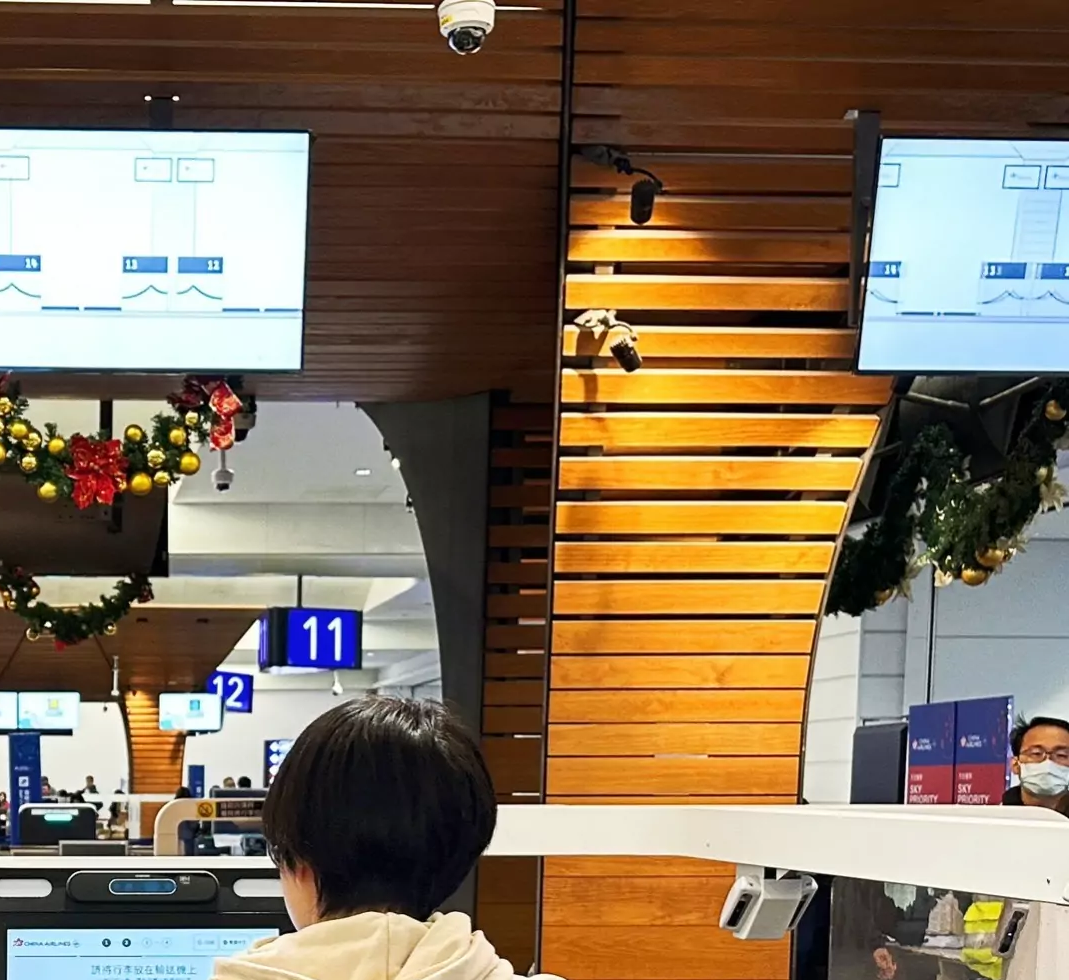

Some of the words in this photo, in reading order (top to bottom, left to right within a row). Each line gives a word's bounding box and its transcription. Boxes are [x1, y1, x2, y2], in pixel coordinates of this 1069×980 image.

[302, 616, 342, 662] 11
[213, 675, 244, 708] 12
[910, 784, 922, 794] SKY
[958, 783, 972, 794] SKY
[909, 794, 939, 804] PRIORITY
[957, 793, 990, 804] PRIORITY
